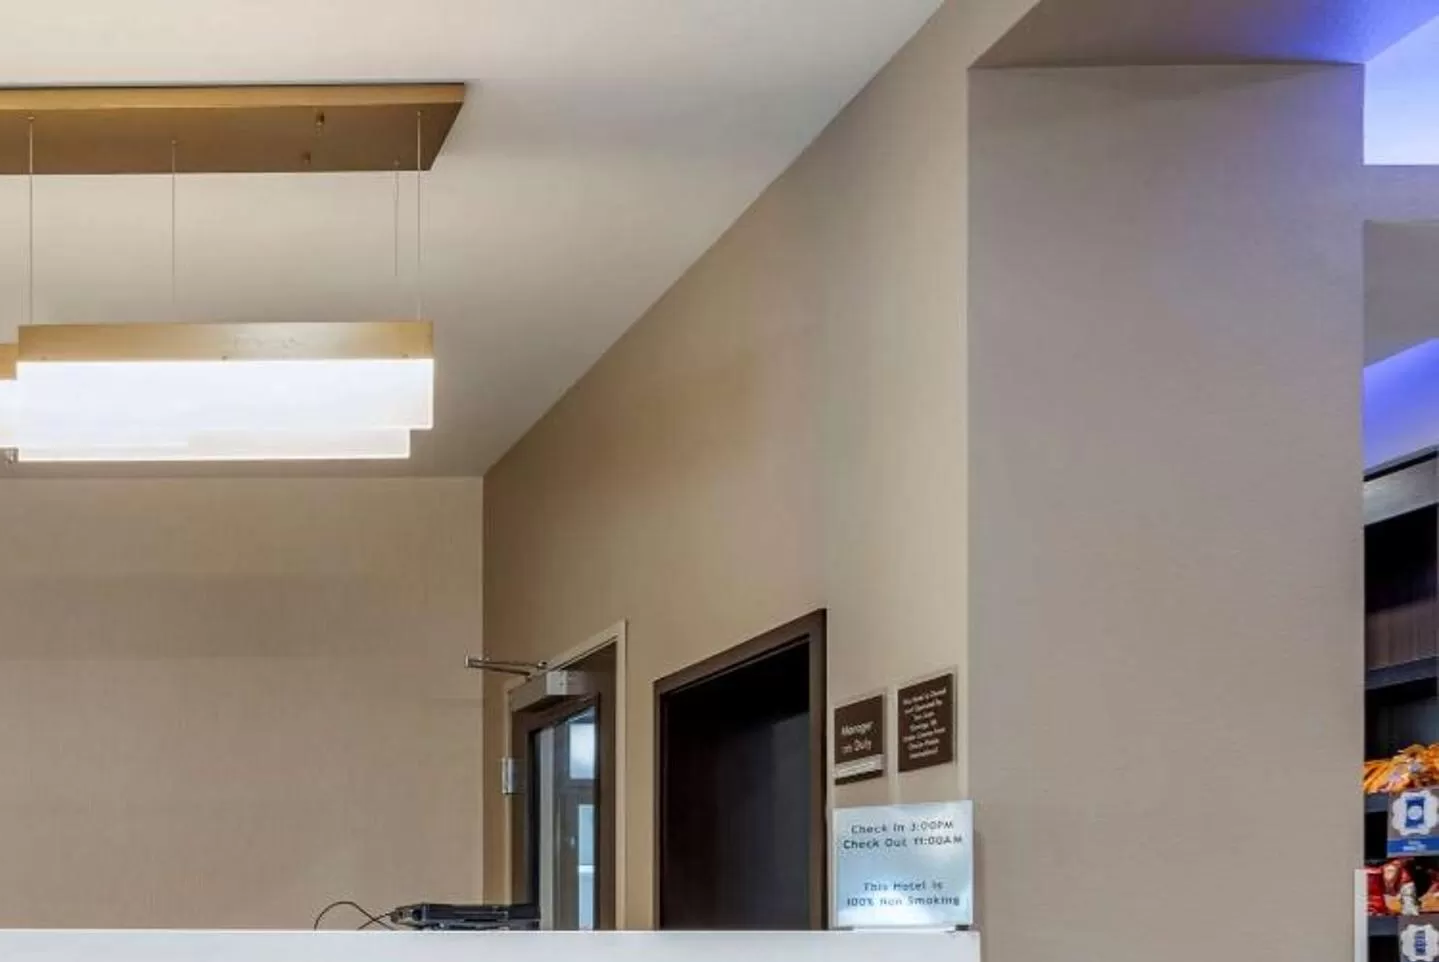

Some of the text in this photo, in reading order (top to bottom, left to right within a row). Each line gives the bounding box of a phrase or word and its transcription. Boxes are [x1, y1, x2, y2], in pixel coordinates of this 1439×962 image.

[851, 823, 887, 834] Check
[843, 835, 963, 849] Check Out 11:00AM
[863, 881, 889, 891] This
[893, 880, 926, 891] Hotel
[908, 894, 960, 907] Smoking
